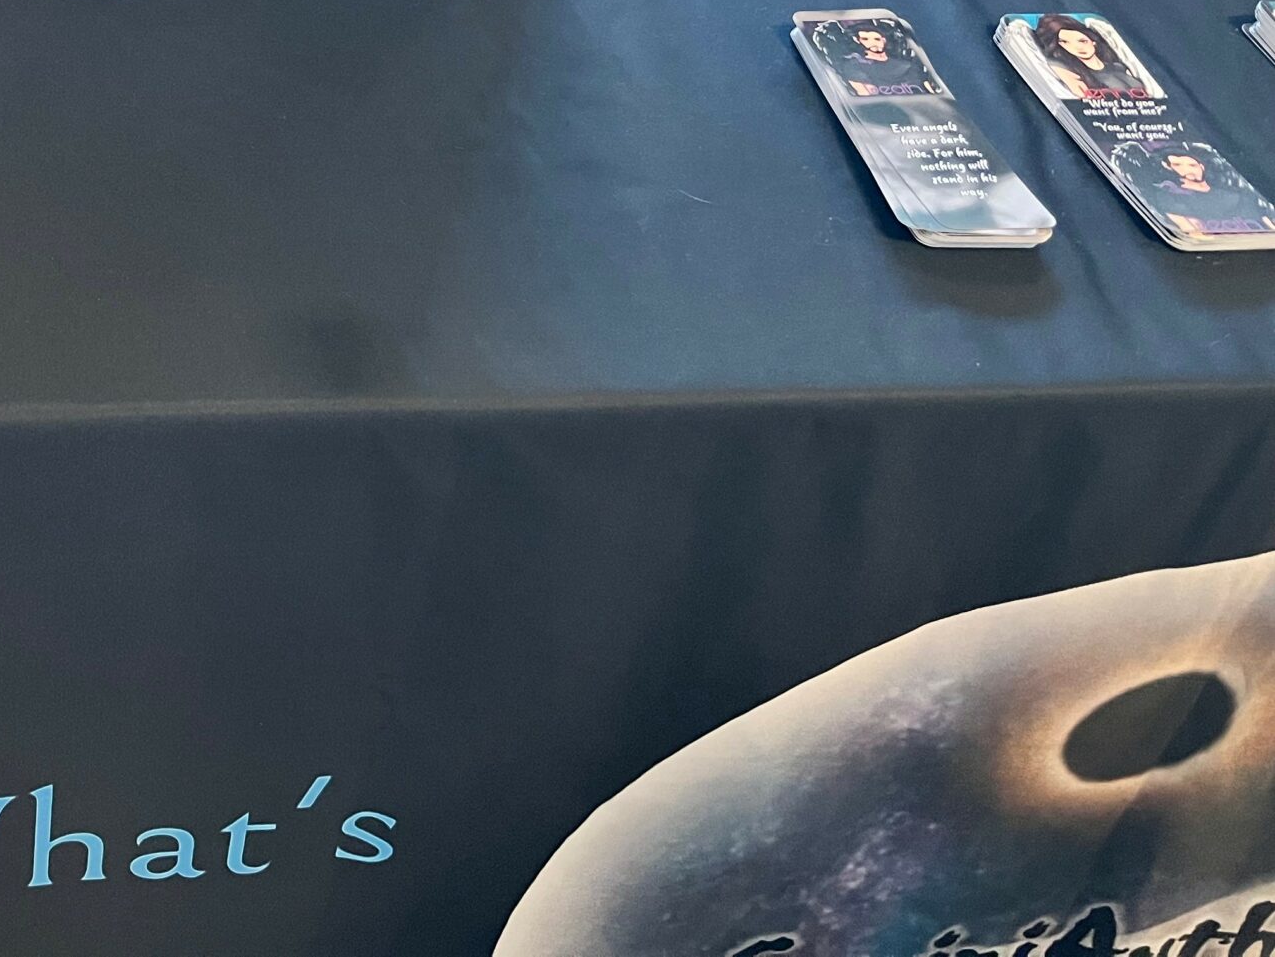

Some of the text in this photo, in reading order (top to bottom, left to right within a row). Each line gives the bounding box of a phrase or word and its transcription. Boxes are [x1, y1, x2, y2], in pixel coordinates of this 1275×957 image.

[1121, 99, 1155, 109] do you
[1083, 108, 1139, 118] want from
[890, 121, 957, 134] Even angels
[1127, 122, 1138, 132] of
[901, 136, 927, 145] have
[940, 134, 969, 145] dark
[1116, 131, 1144, 140] want
[932, 148, 953, 158] For
[921, 159, 989, 173] nothing will
[932, 172, 997, 184] stand in his
[960, 189, 988, 199] way.
